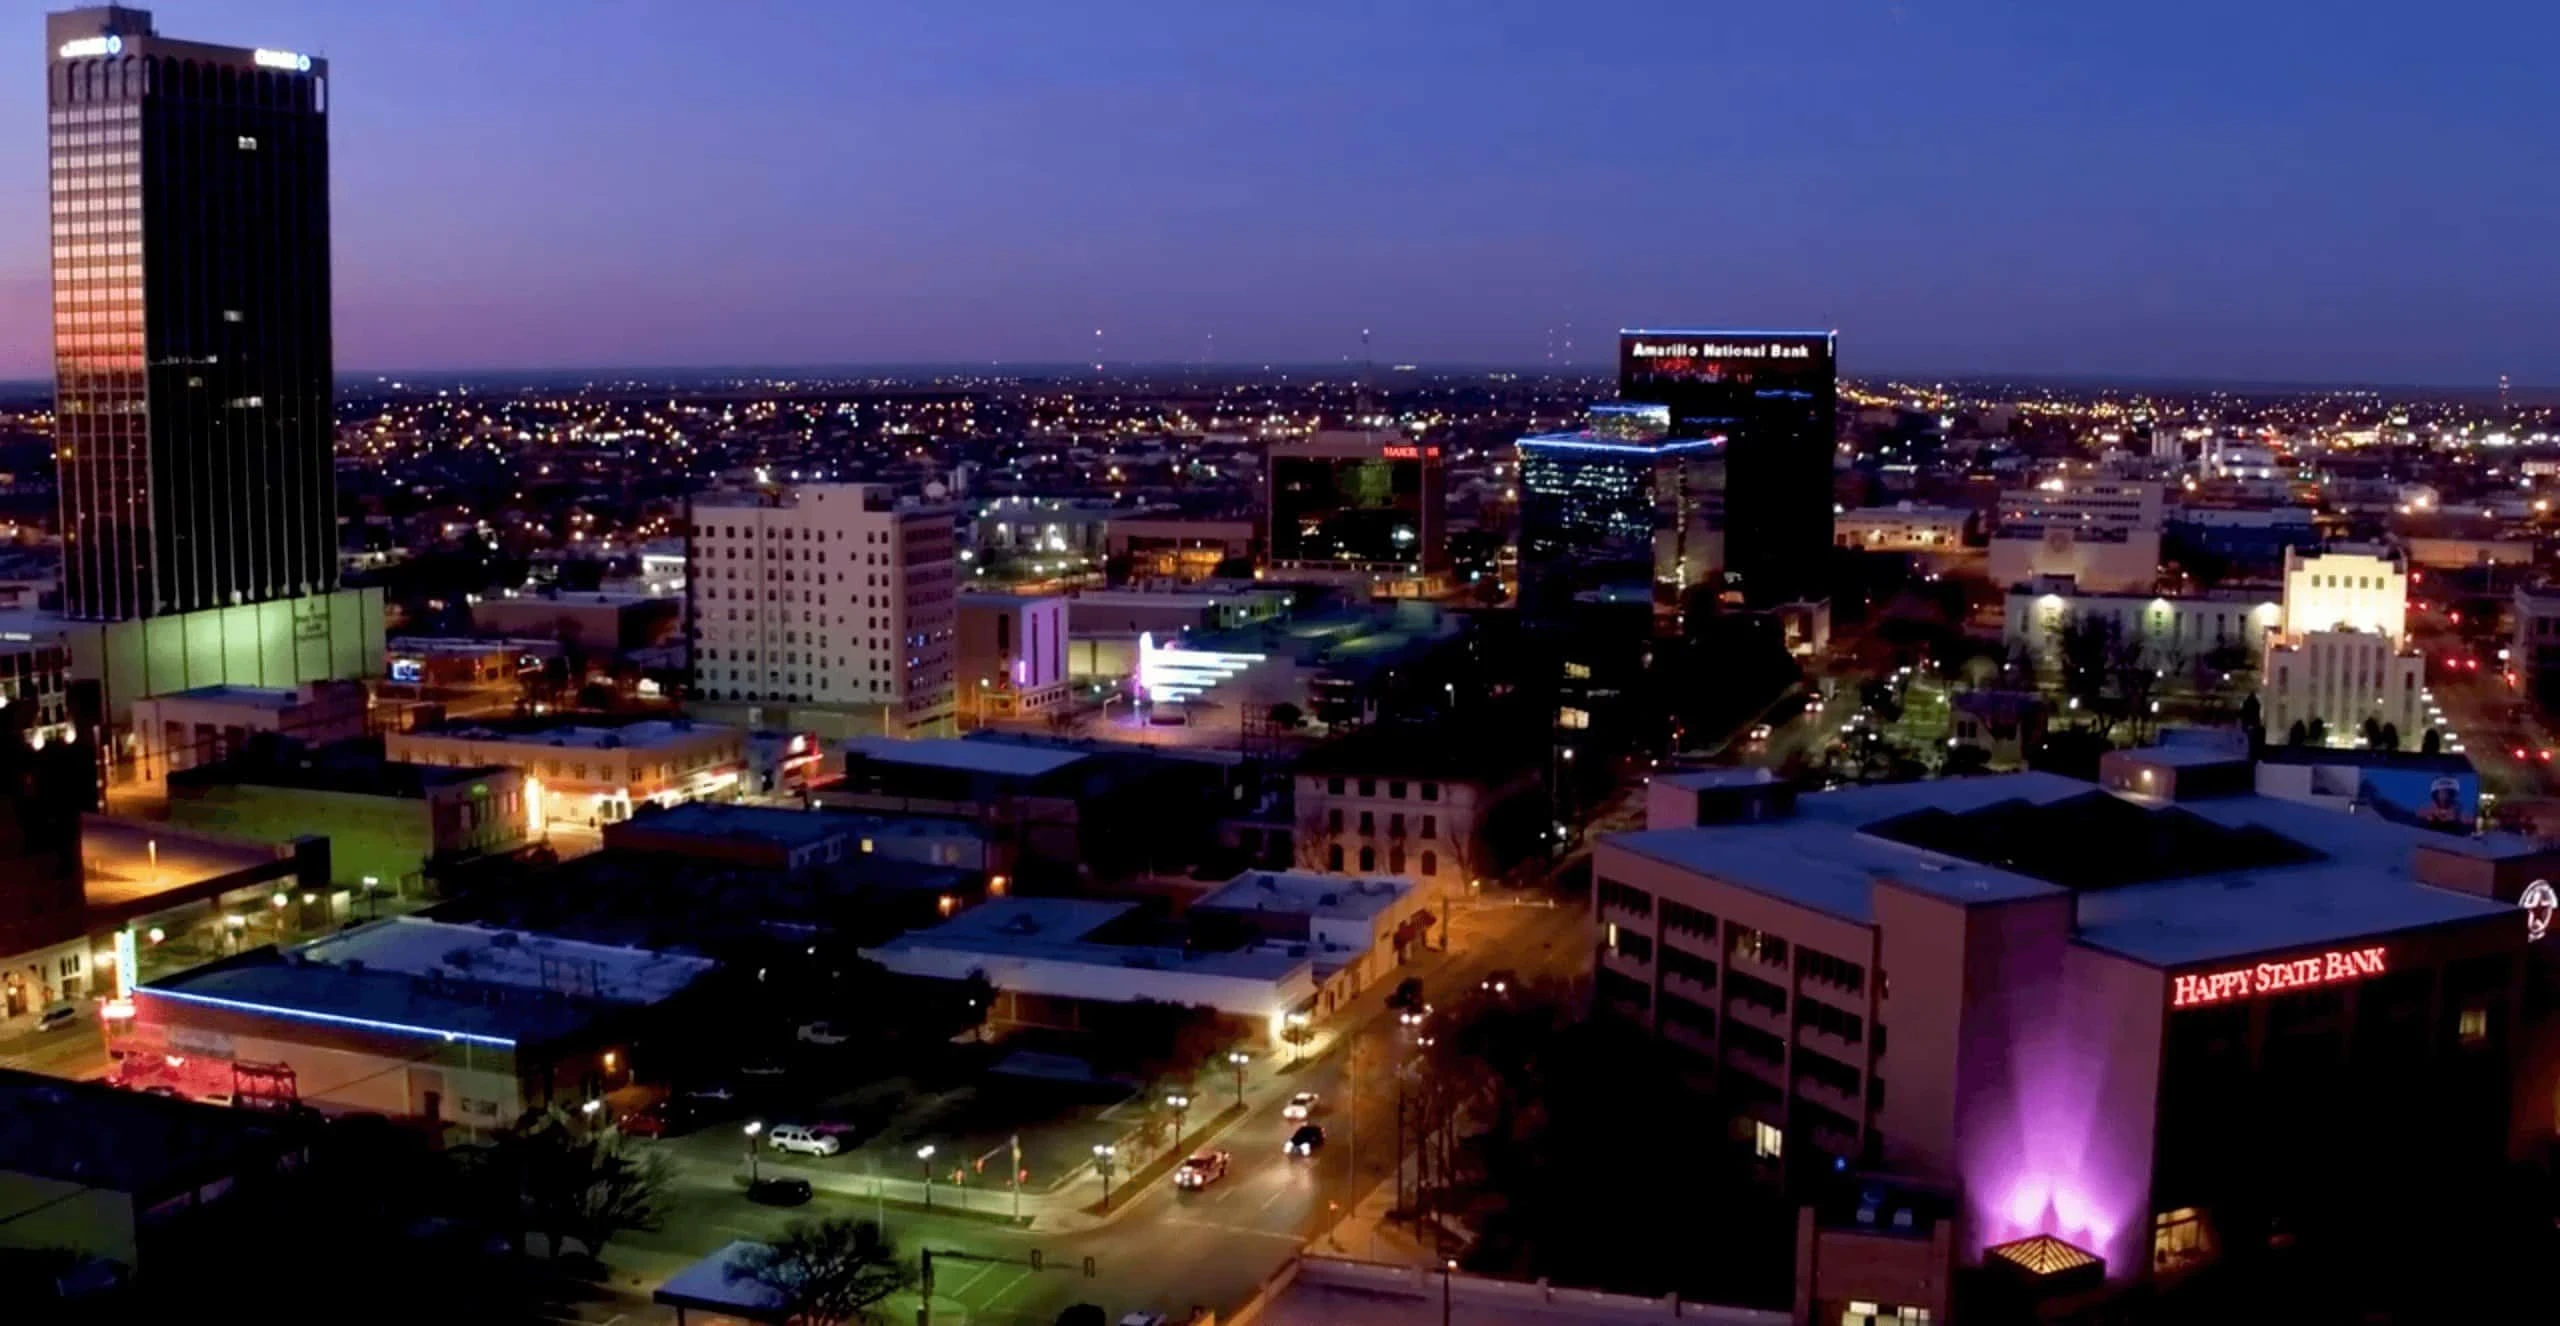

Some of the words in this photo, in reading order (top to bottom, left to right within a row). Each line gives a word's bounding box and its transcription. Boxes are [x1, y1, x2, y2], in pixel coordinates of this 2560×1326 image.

[1632, 342, 1699, 358] Amarillo
[1703, 343, 1766, 358] National
[1770, 343, 1809, 358] Bank
[2173, 969, 2253, 1006] HAPPY
[2255, 957, 2322, 992] STATE
[2324, 947, 2385, 981] BANK
